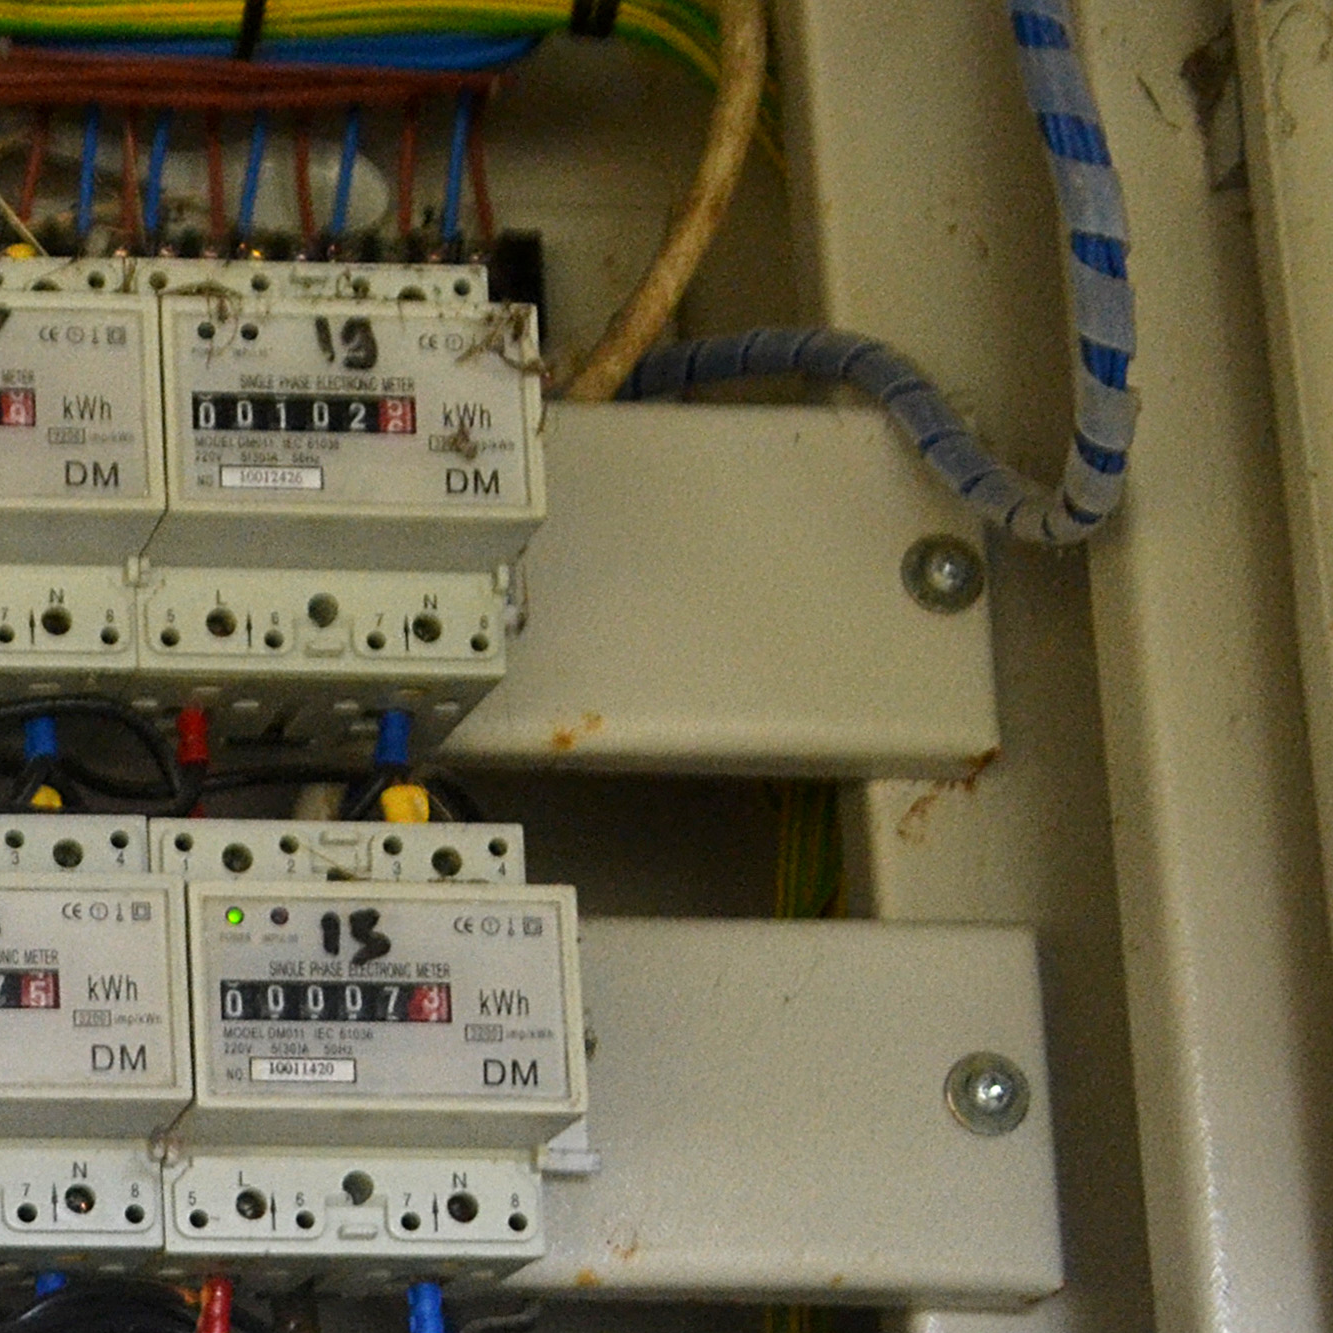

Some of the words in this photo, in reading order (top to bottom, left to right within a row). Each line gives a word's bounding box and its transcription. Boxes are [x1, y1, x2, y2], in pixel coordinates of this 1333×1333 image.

[63, 394, 112, 421] kWh
[442, 402, 492, 429] kWh
[64, 460, 119, 487] DM
[445, 467, 499, 495] DM
[87, 973, 138, 1001] kWh
[479, 988, 530, 1016] kWh
[90, 1043, 147, 1071] DM
[268, 1061, 334, 1076] 10011420
[482, 1058, 538, 1086] DM
